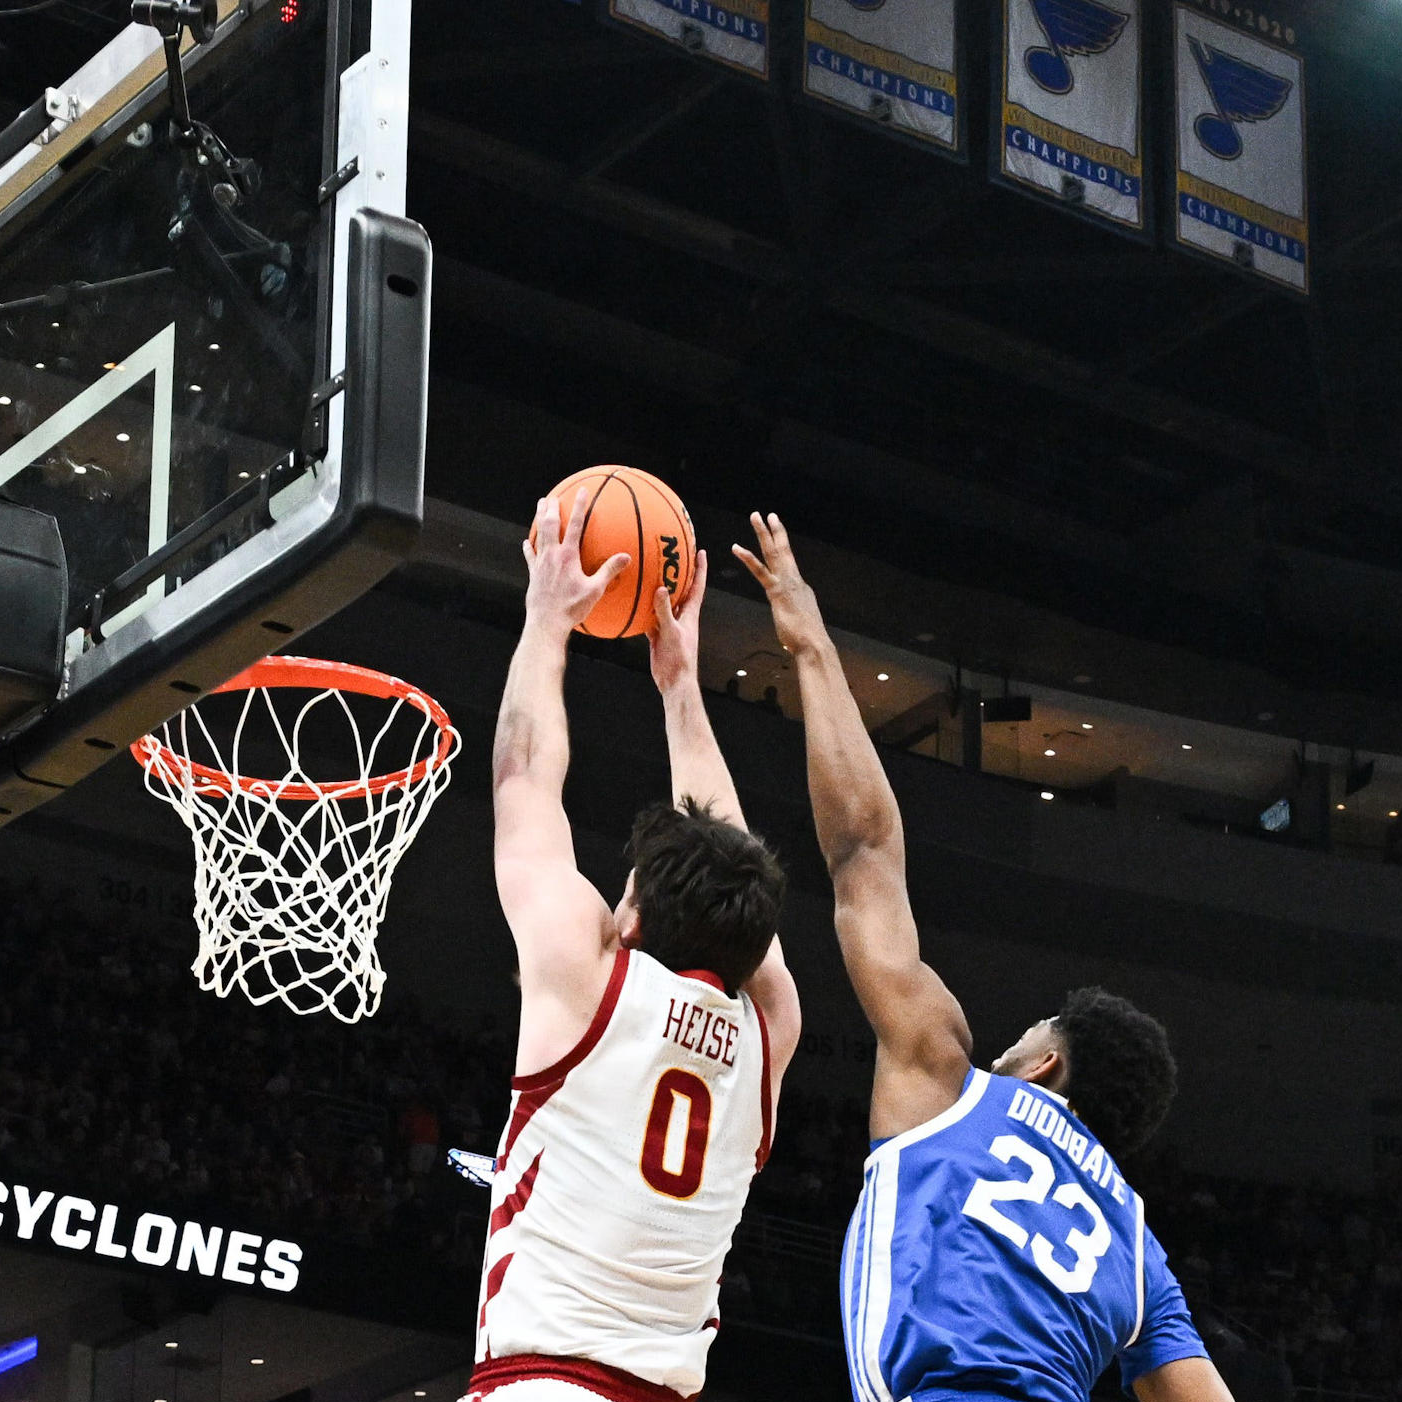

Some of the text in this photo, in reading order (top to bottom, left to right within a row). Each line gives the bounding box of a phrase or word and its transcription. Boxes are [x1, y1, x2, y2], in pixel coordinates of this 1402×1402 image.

[814, 48, 949, 112] CHAMPIONS
[1011, 129, 1133, 194] CHAMPIONS
[1186, 195, 1301, 260] CHAMPIONS
[662, 998, 740, 1068] HEISE
[640, 1067, 713, 1200] 0
[961, 1135, 1112, 1294] 23
